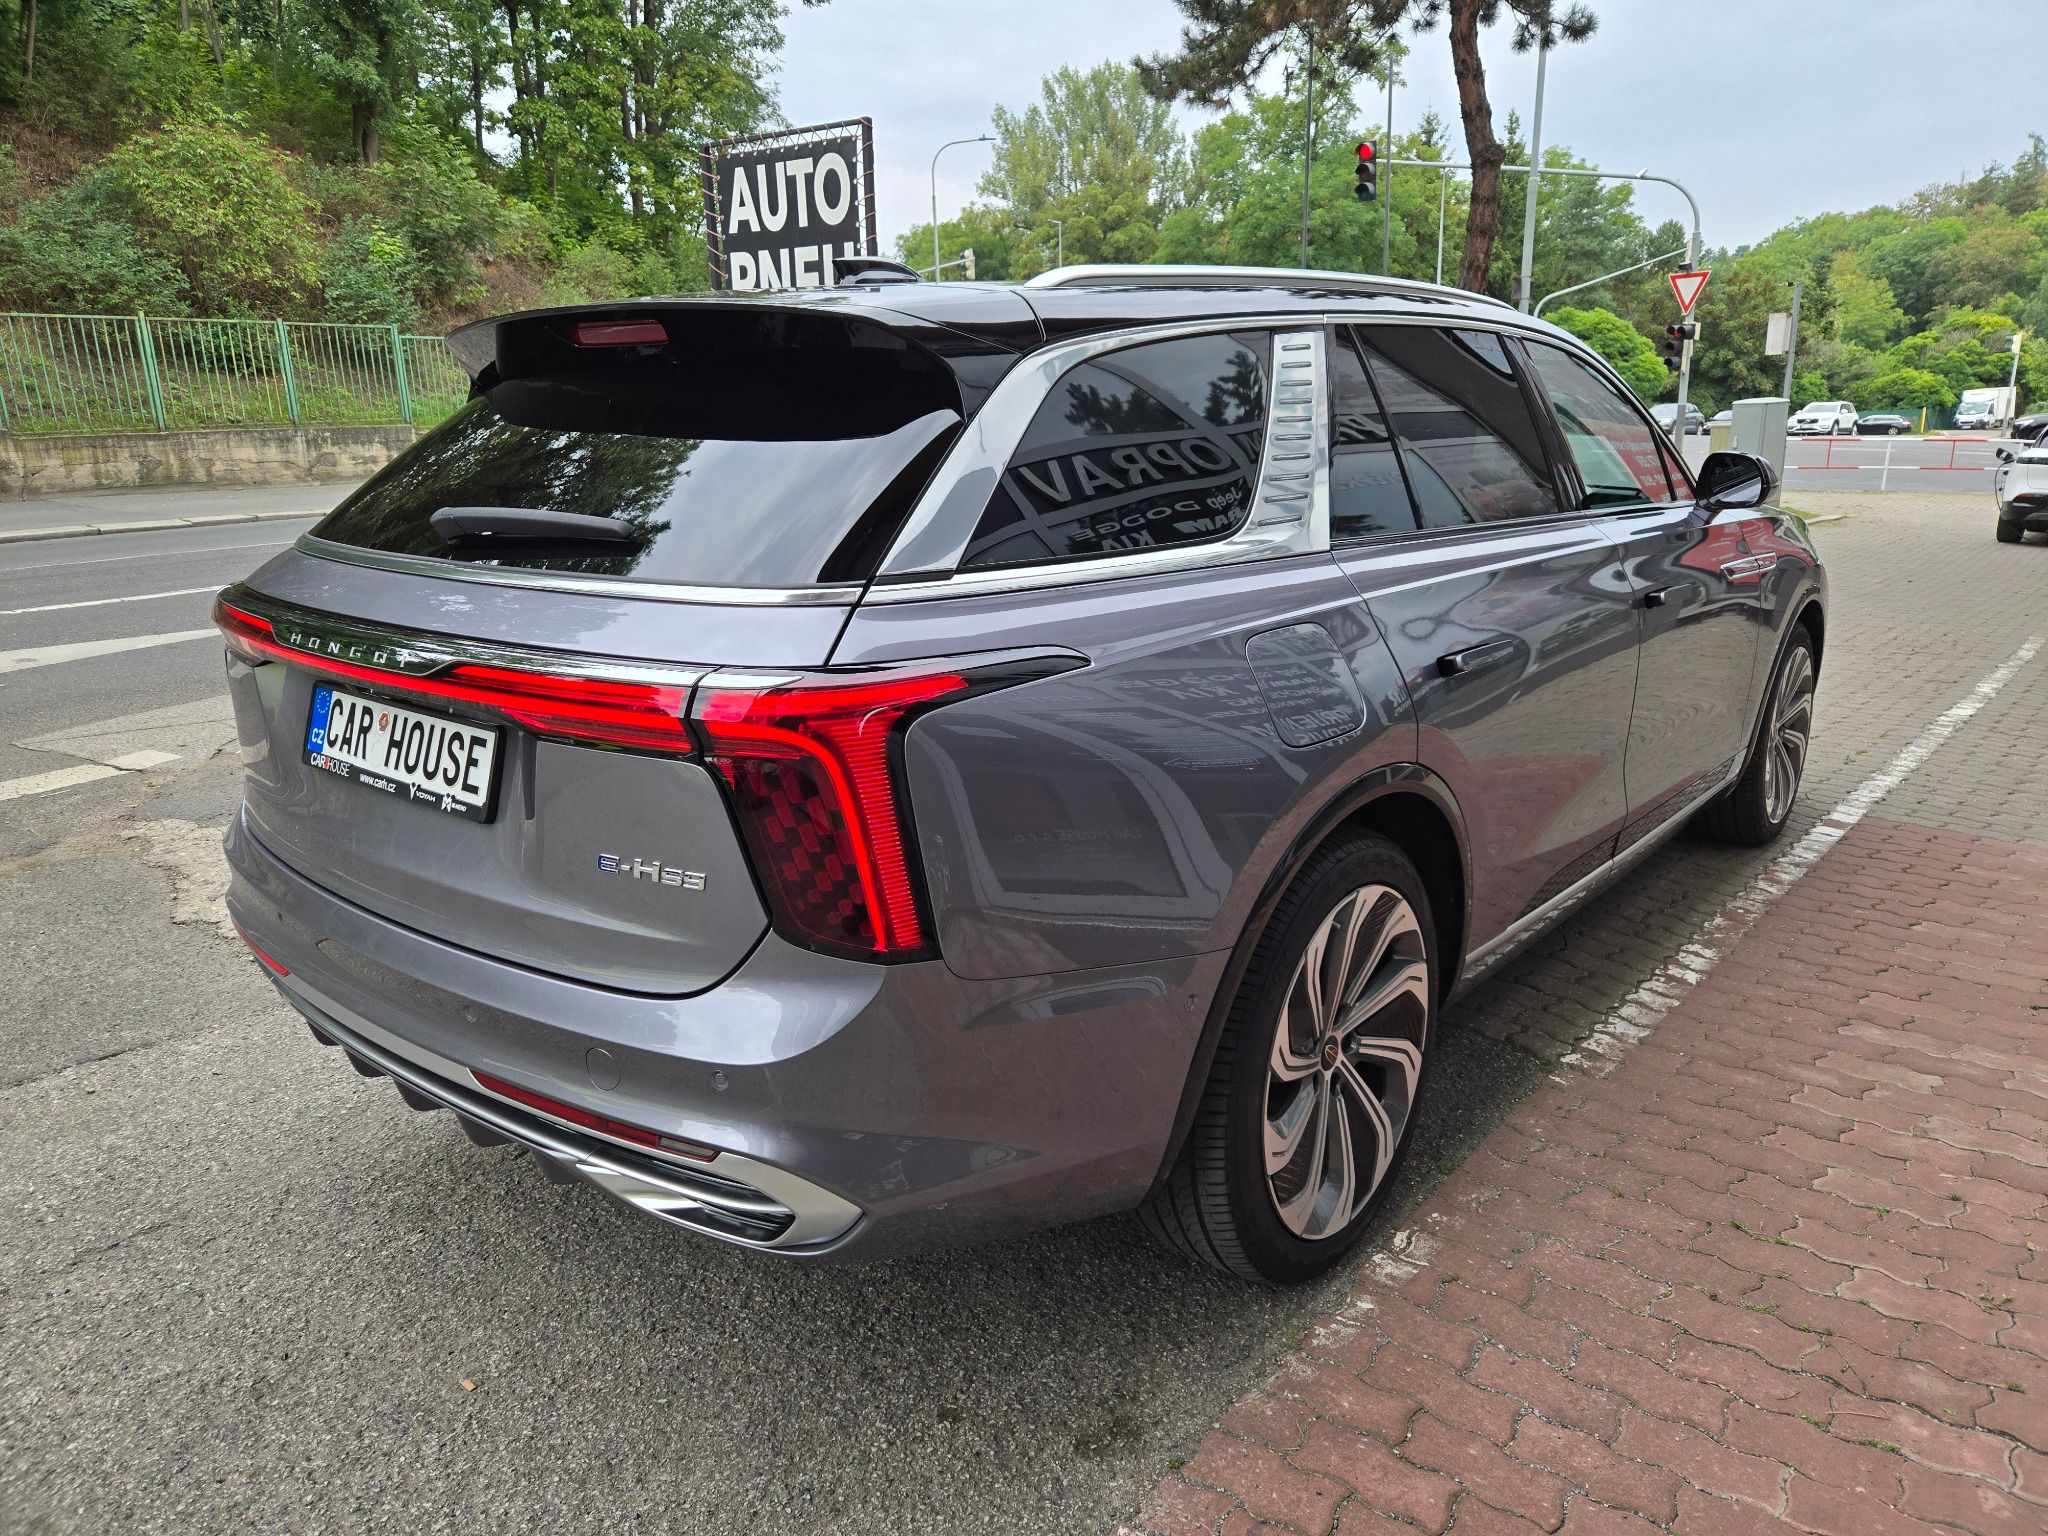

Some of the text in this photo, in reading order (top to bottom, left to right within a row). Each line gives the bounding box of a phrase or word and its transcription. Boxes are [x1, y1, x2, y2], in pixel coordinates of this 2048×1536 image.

[729, 152, 851, 234] AUTO
[311, 727, 326, 745] CZ
[326, 697, 488, 796] CAR HOUSE
[310, 753, 351, 777] CAR HOUSE
